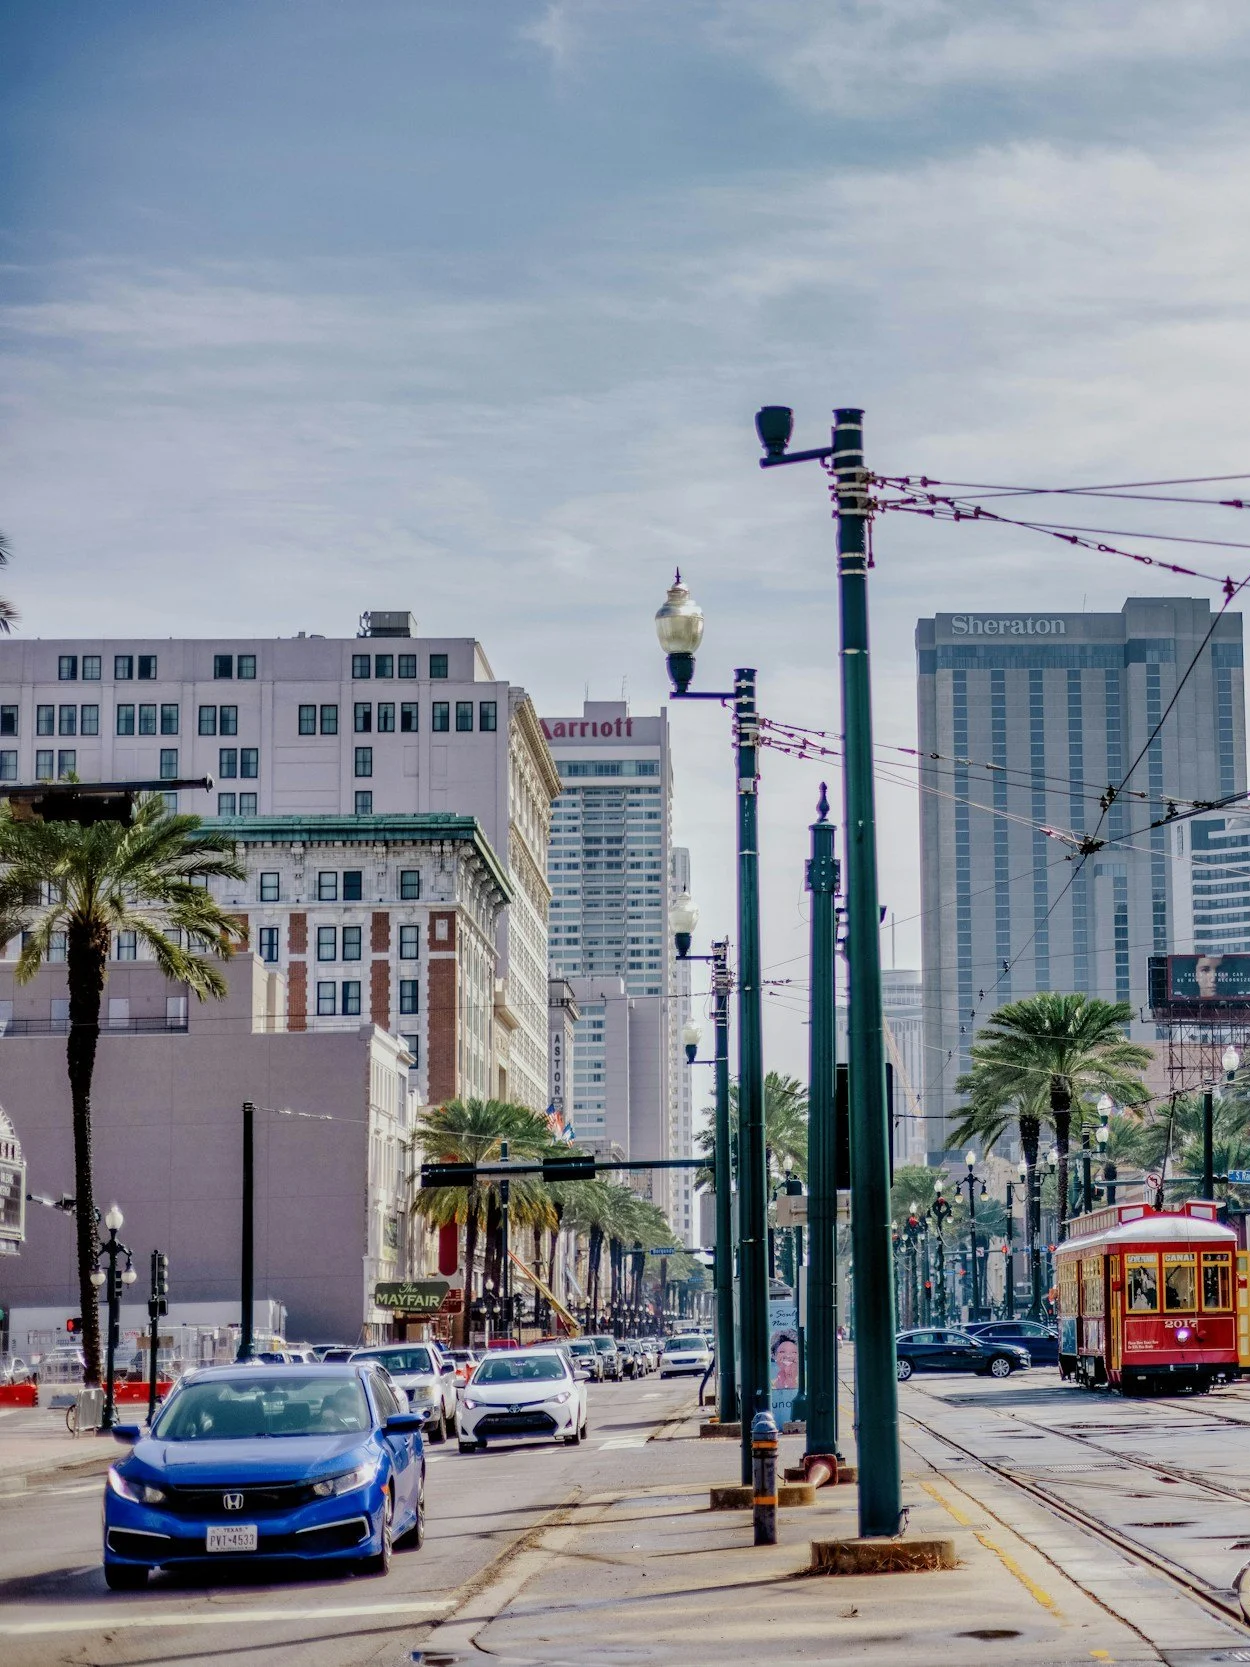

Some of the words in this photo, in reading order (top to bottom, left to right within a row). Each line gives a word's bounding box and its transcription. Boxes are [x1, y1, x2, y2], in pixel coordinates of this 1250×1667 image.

[951, 615, 1067, 635] Sheraton
[1165, 1253, 1194, 1262] CANAL
[399, 1282, 418, 1293] The
[376, 1294, 440, 1307] MAYFAIR
[1164, 1320, 1198, 1329] 2017
